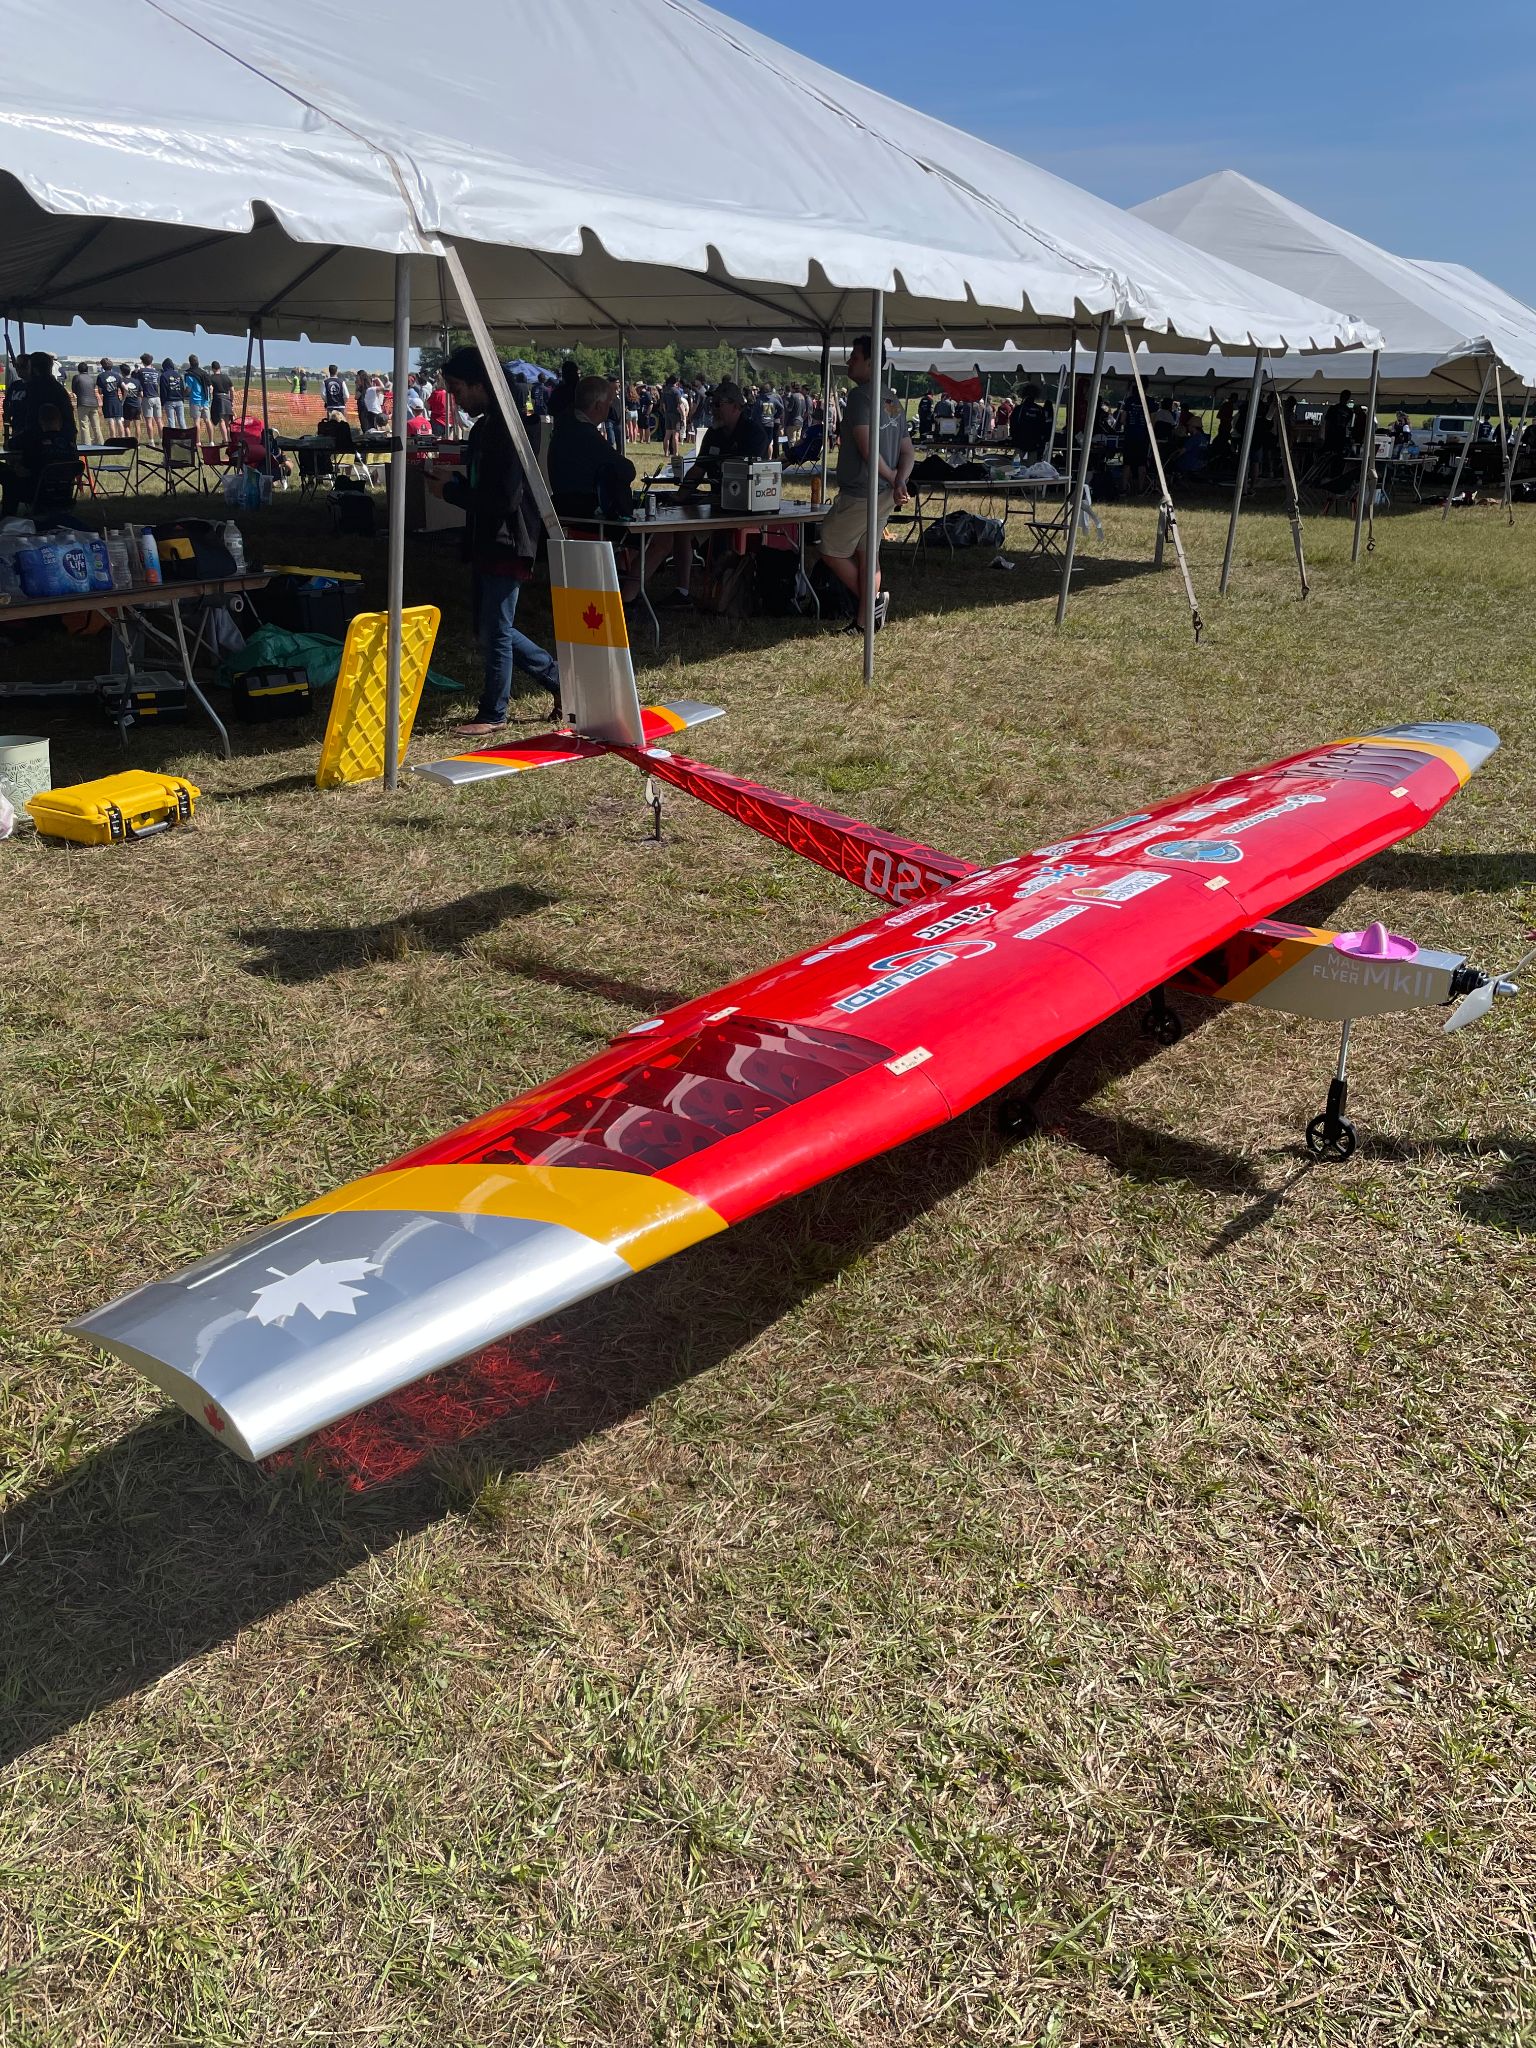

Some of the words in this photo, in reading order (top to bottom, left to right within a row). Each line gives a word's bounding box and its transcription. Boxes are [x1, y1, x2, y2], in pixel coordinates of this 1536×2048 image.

[755, 487, 777, 498] DX20
[1016, 905, 1087, 939] ENGINEERING
[834, 950, 955, 1012] LIBURDI
[1312, 965, 1359, 985] FLYER
